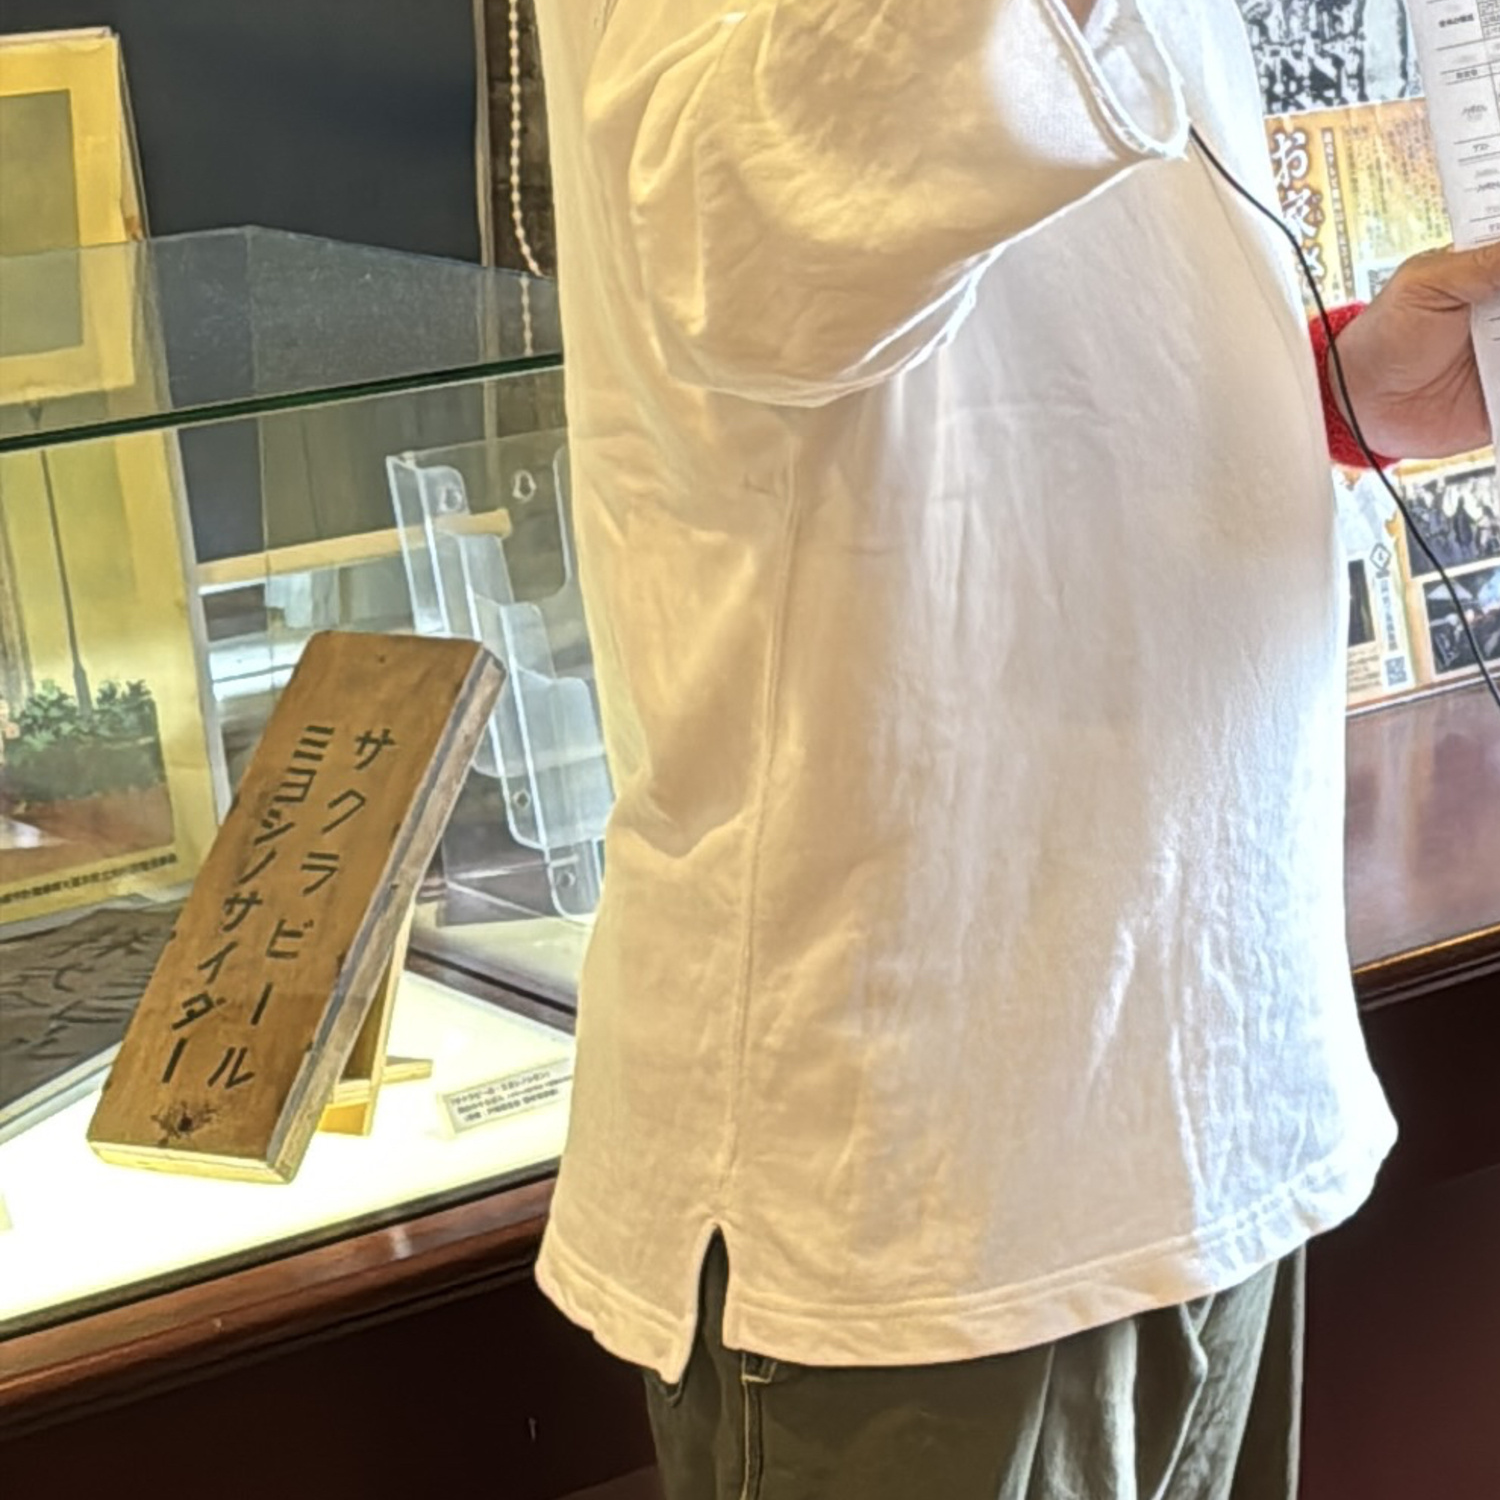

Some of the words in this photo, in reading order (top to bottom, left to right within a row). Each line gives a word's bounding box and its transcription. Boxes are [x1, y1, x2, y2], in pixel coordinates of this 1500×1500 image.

[162, 725, 334, 1083] ミヨシノサイダー
[207, 728, 397, 1090] サクラビール
